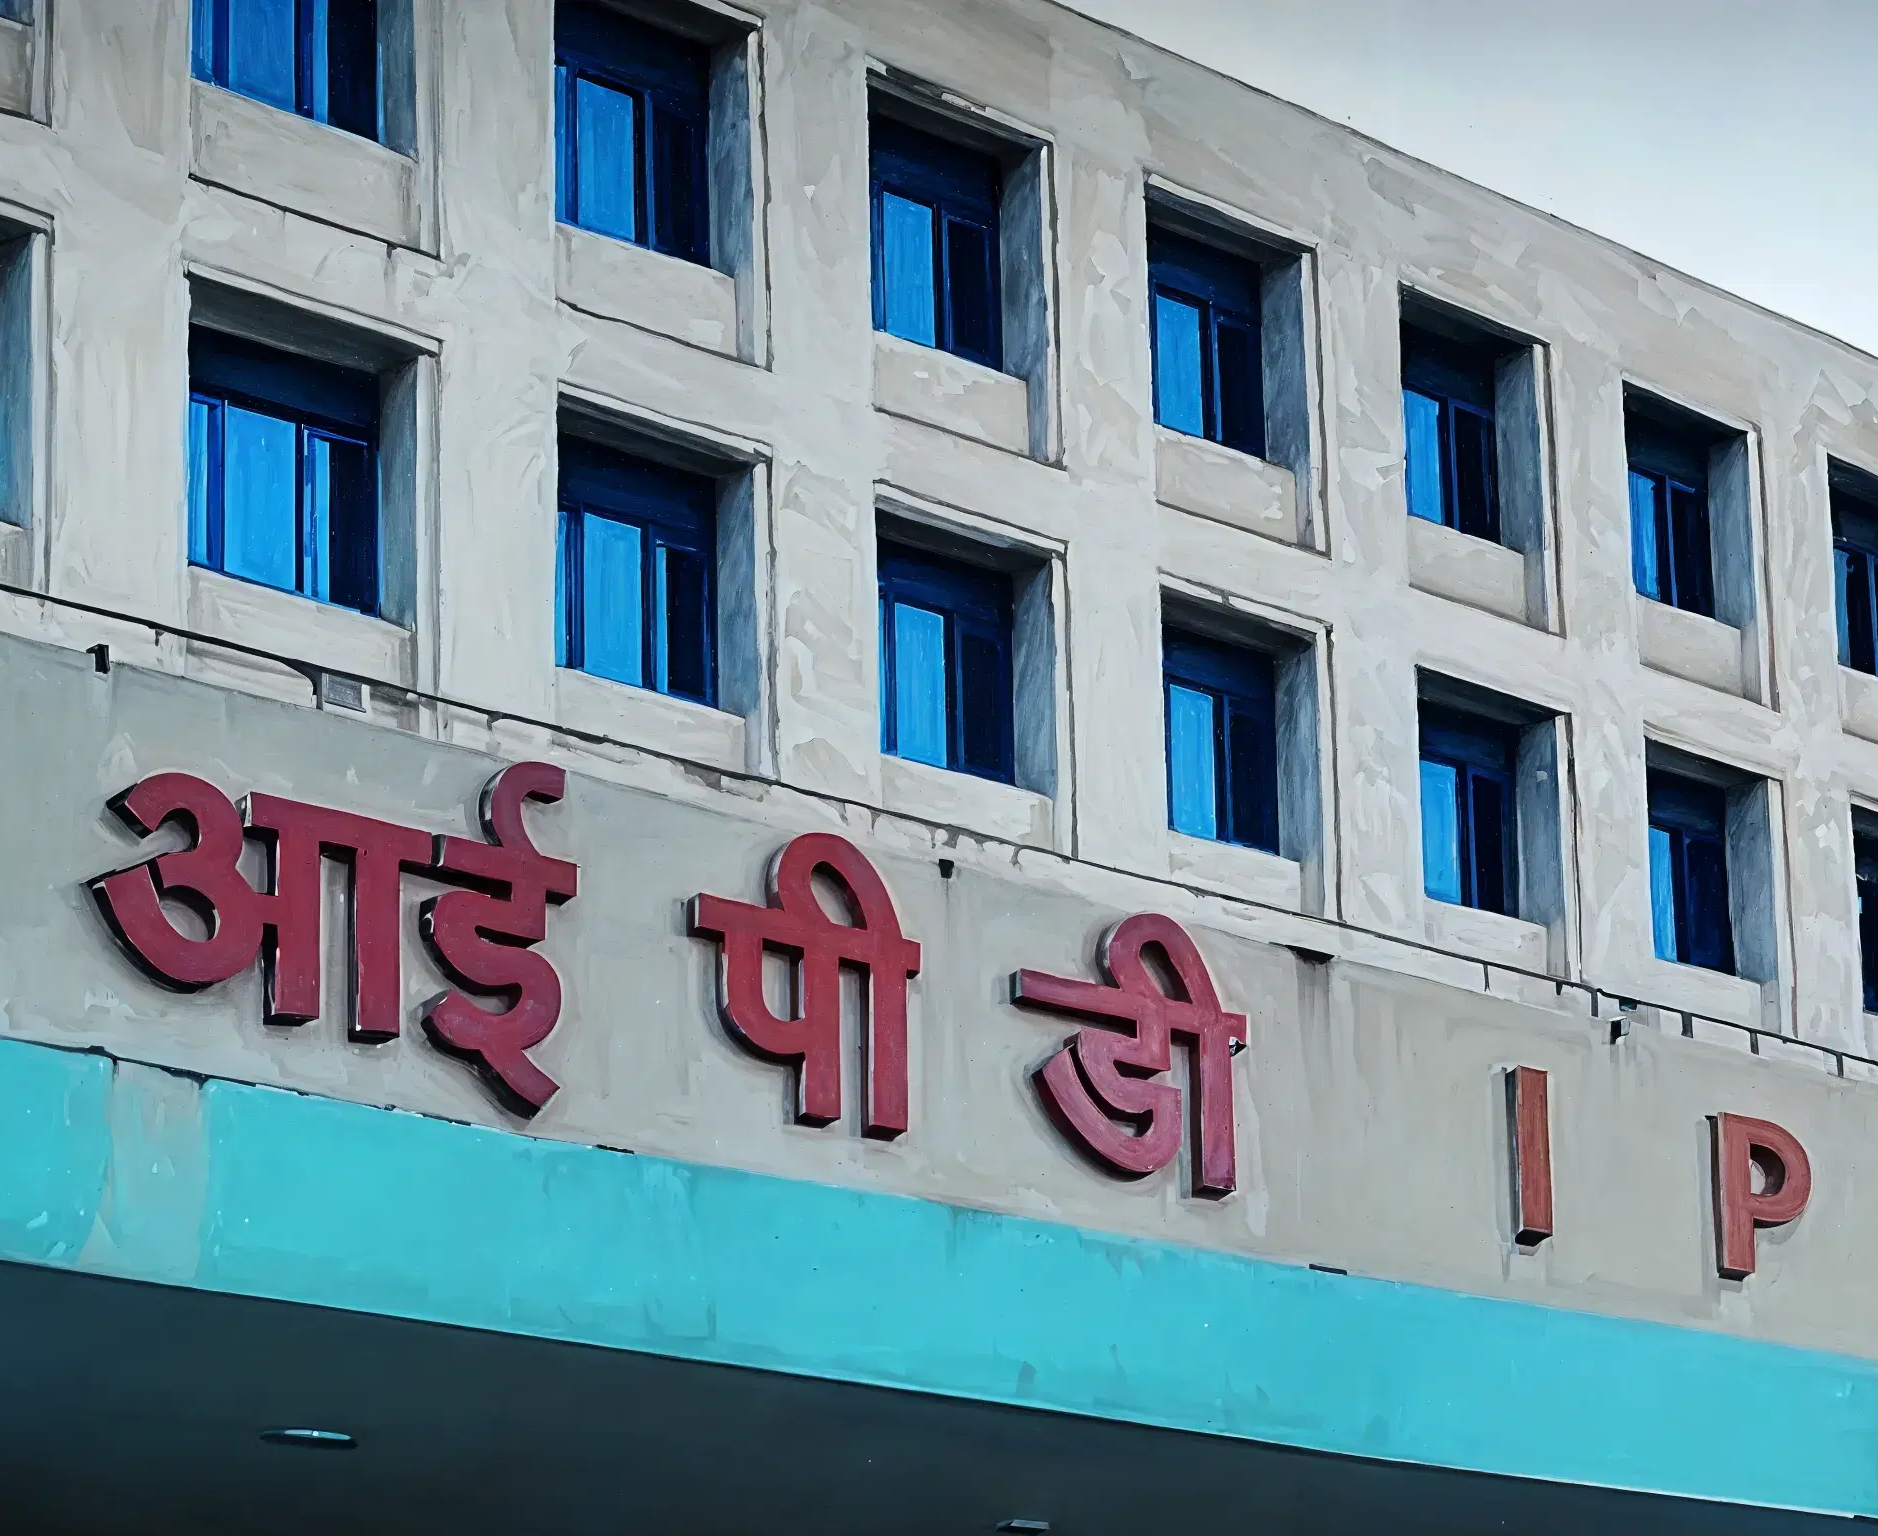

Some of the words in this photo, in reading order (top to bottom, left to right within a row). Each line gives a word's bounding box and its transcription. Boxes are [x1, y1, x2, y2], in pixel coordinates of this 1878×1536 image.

[80, 761, 577, 1120] आई
[688, 832, 920, 1141] पी
[1010, 913, 1246, 1200] डी
